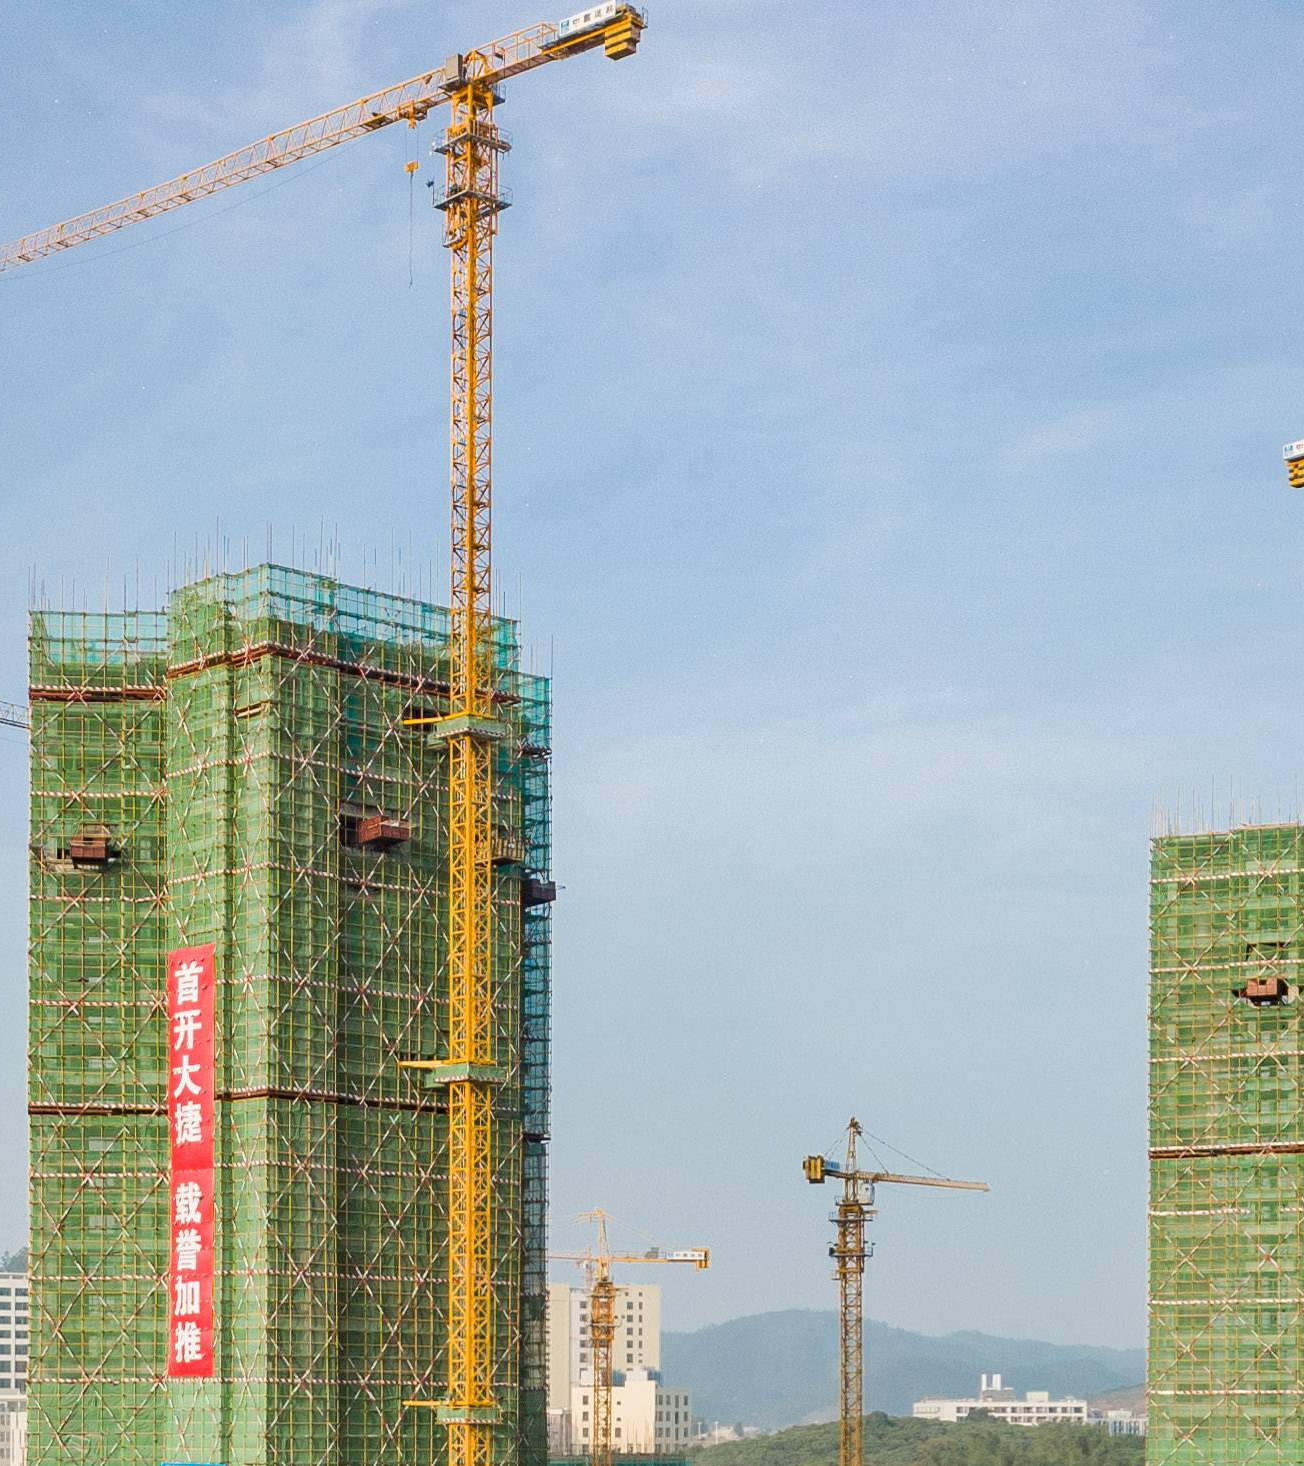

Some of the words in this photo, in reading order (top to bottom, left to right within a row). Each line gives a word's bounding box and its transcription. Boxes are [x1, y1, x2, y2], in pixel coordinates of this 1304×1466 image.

[173, 960, 204, 1145] 首开大捷
[174, 1181, 203, 1364] 载誉加推
